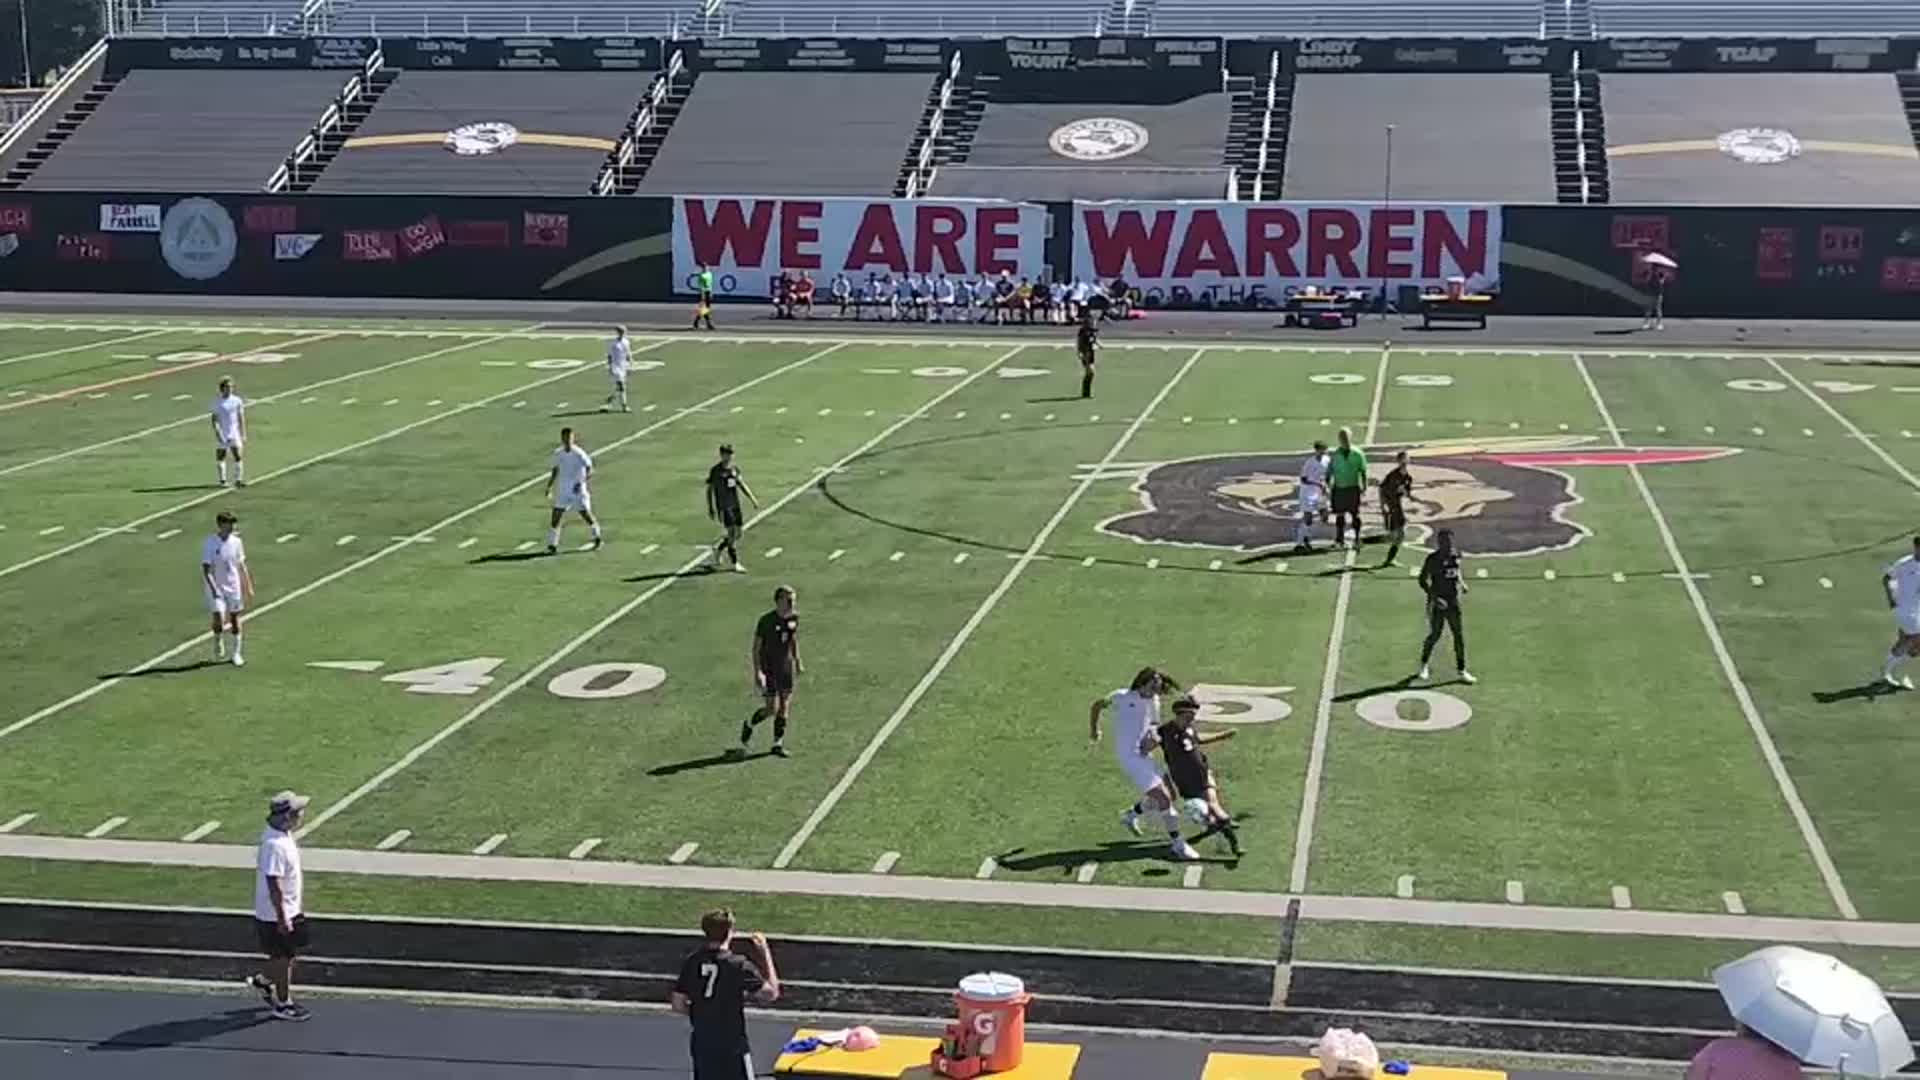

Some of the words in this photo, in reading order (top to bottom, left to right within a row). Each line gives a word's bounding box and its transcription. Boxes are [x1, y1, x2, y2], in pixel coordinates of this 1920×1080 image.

[1296, 55, 1362, 68] GROUP
[684, 199, 824, 269] WE
[844, 203, 1021, 275] ARE
[1083, 208, 1488, 278] WARREN
[701, 964, 719, 997] 7
[974, 1013, 993, 1035] G
